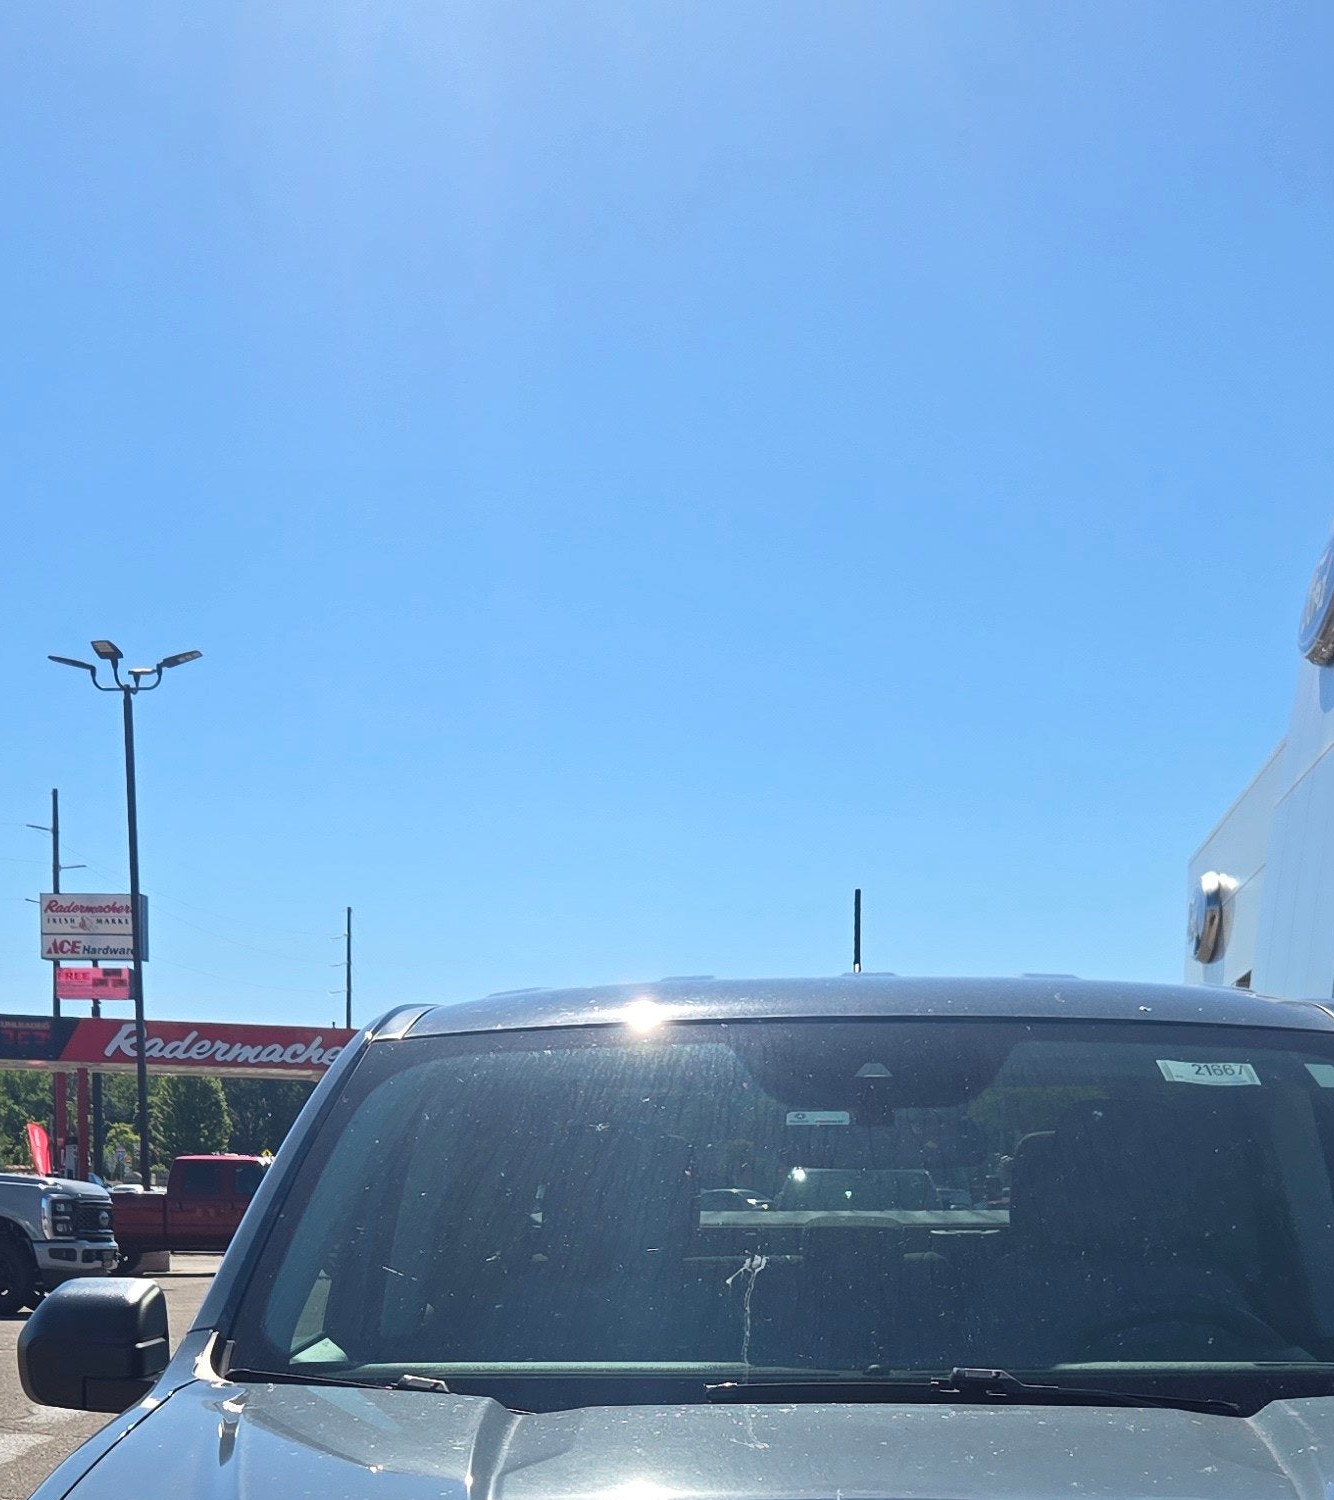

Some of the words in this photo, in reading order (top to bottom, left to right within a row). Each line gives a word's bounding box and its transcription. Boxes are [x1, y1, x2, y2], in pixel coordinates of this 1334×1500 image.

[44, 899, 132, 914] Radermacher
[96, 917, 130, 925] MARKE
[46, 938, 82, 955] ACE
[104, 1023, 346, 1066] Radermache
[1192, 1063, 1244, 1077] 21667
